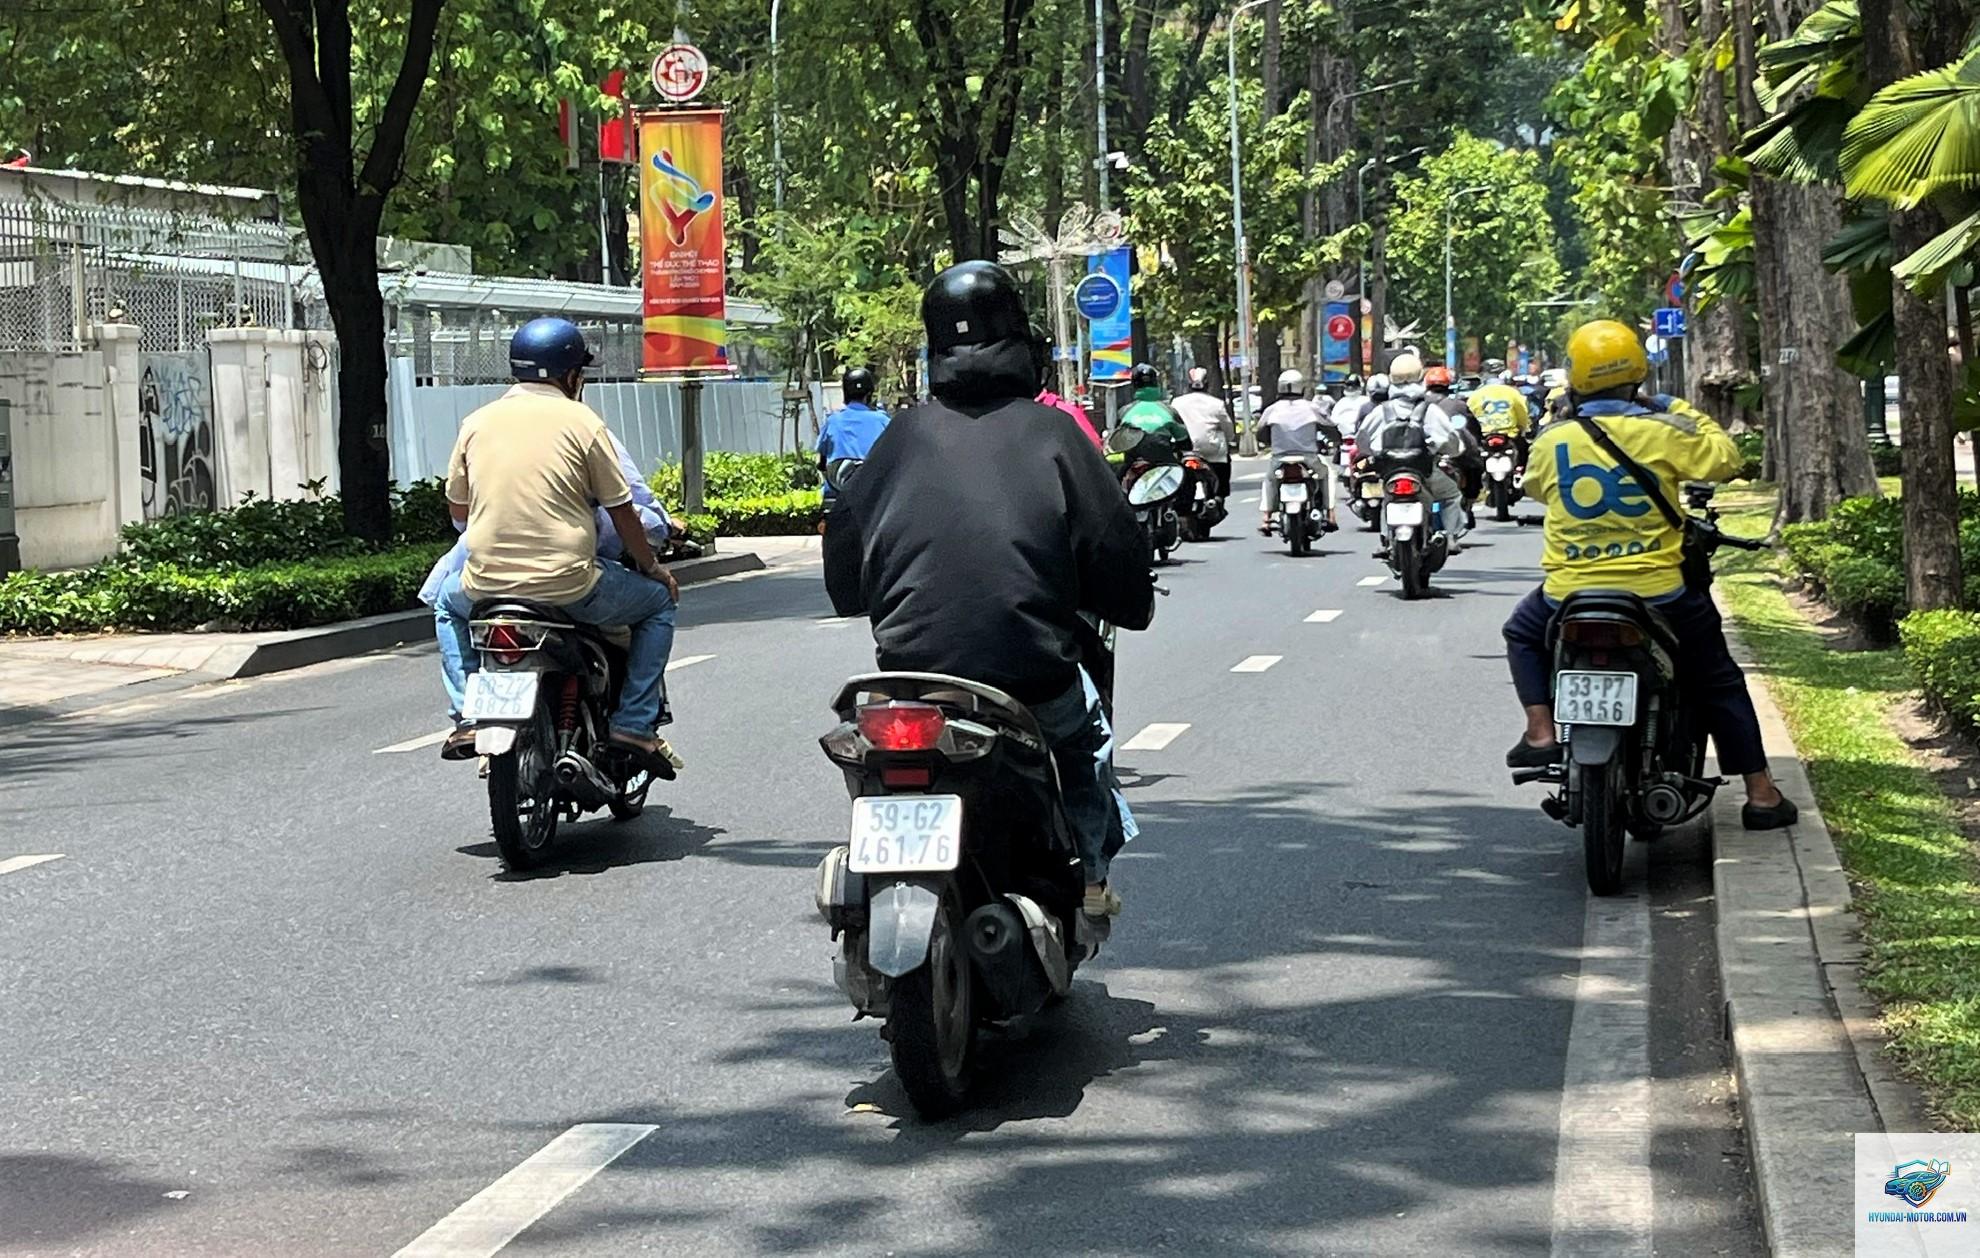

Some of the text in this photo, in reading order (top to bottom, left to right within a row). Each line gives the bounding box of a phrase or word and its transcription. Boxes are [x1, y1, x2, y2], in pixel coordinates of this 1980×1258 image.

[1555, 442, 1660, 520] be
[869, 801, 943, 832] 59-G2
[857, 834, 951, 865] 461.76
